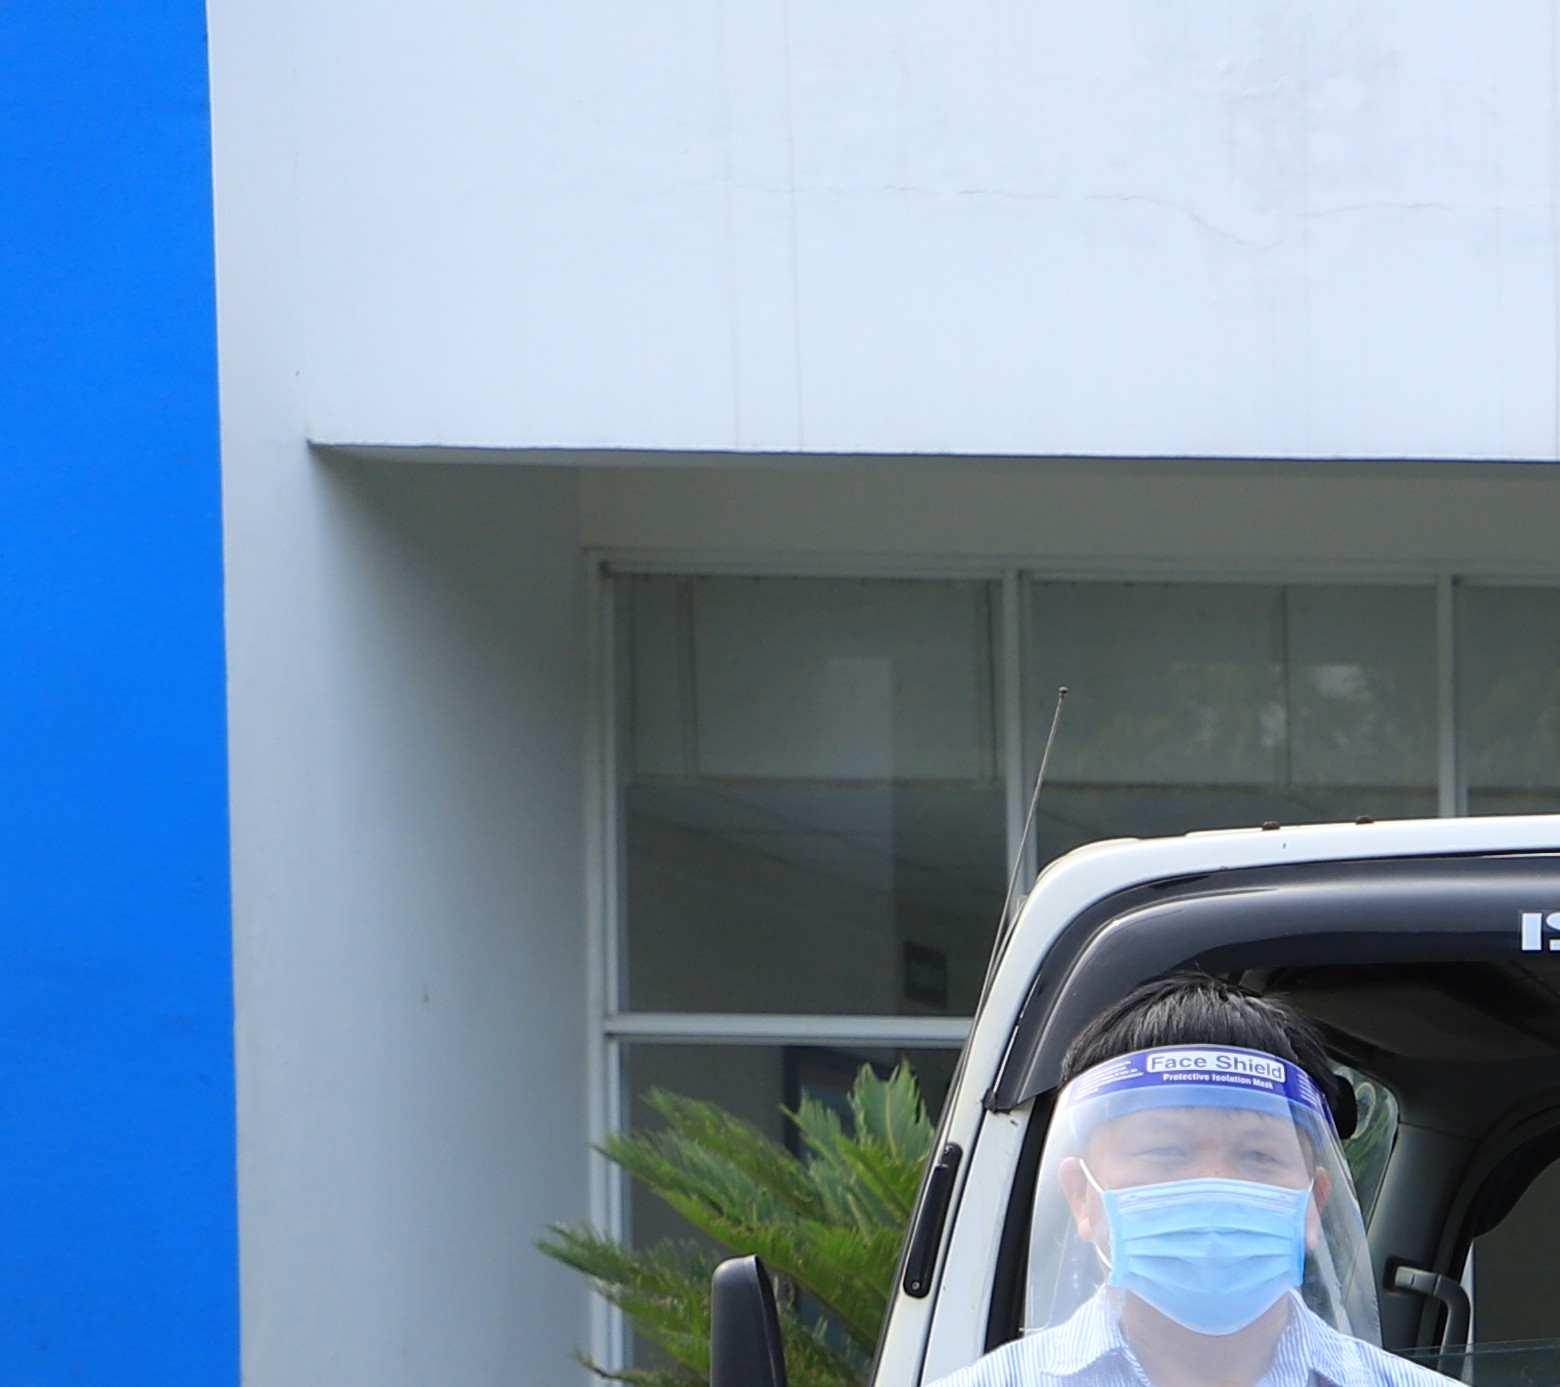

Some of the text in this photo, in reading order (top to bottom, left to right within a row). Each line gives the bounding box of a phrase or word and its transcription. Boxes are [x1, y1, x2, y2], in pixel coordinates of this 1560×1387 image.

[1150, 1054, 1284, 1081] Face Shield
[1162, 1072, 1274, 1090] Protective Isolation Mask
